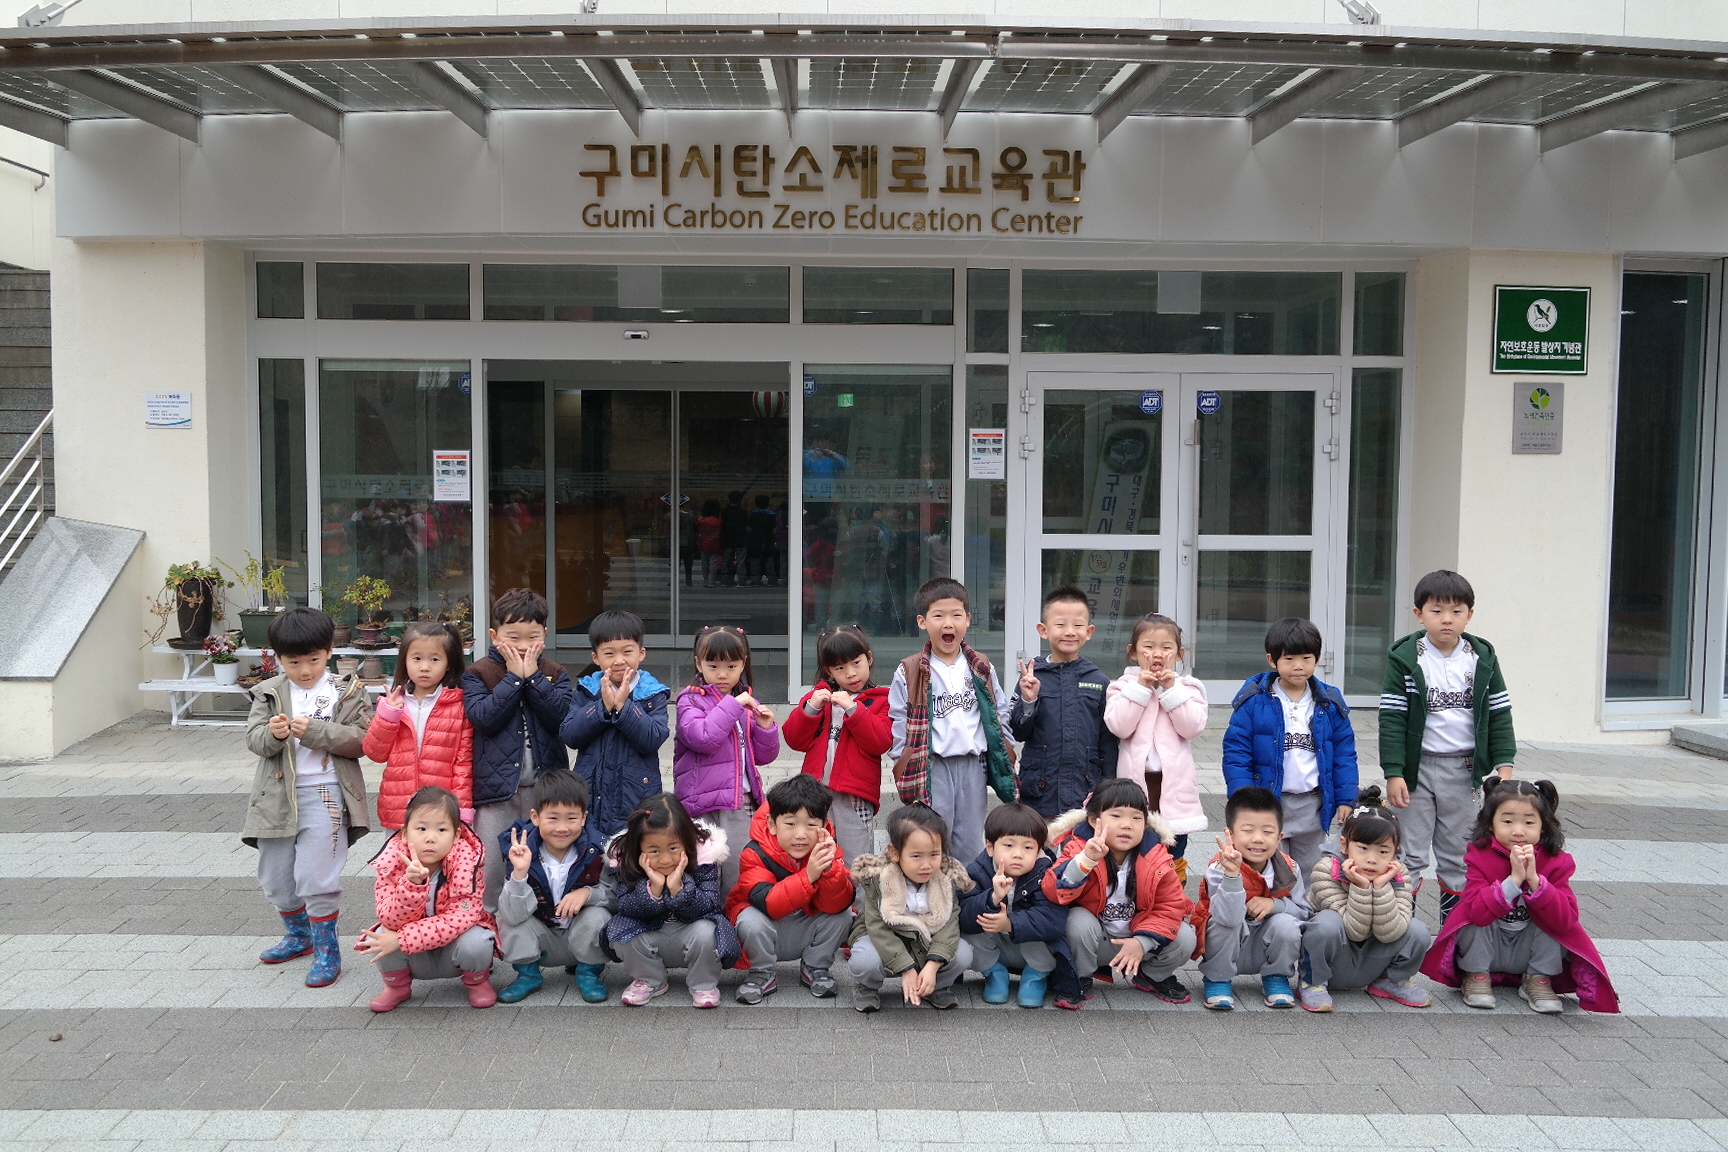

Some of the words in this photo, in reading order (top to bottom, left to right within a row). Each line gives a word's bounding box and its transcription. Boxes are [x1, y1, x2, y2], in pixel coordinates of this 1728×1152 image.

[578, 143, 1087, 203] 구미시탄소제로교육관
[581, 202, 655, 229] Gumi
[663, 203, 763, 231] Carbon
[772, 204, 836, 230] Zero
[845, 204, 982, 233] Education
[991, 207, 1084, 234] Center
[1500, 341, 1540, 353] 자연보호운동
[1541, 341, 1561, 354] 발상지
[1562, 342, 1582, 354] 기념관
[1142, 397, 1159, 407] ADT
[1200, 397, 1217, 407] ADT
